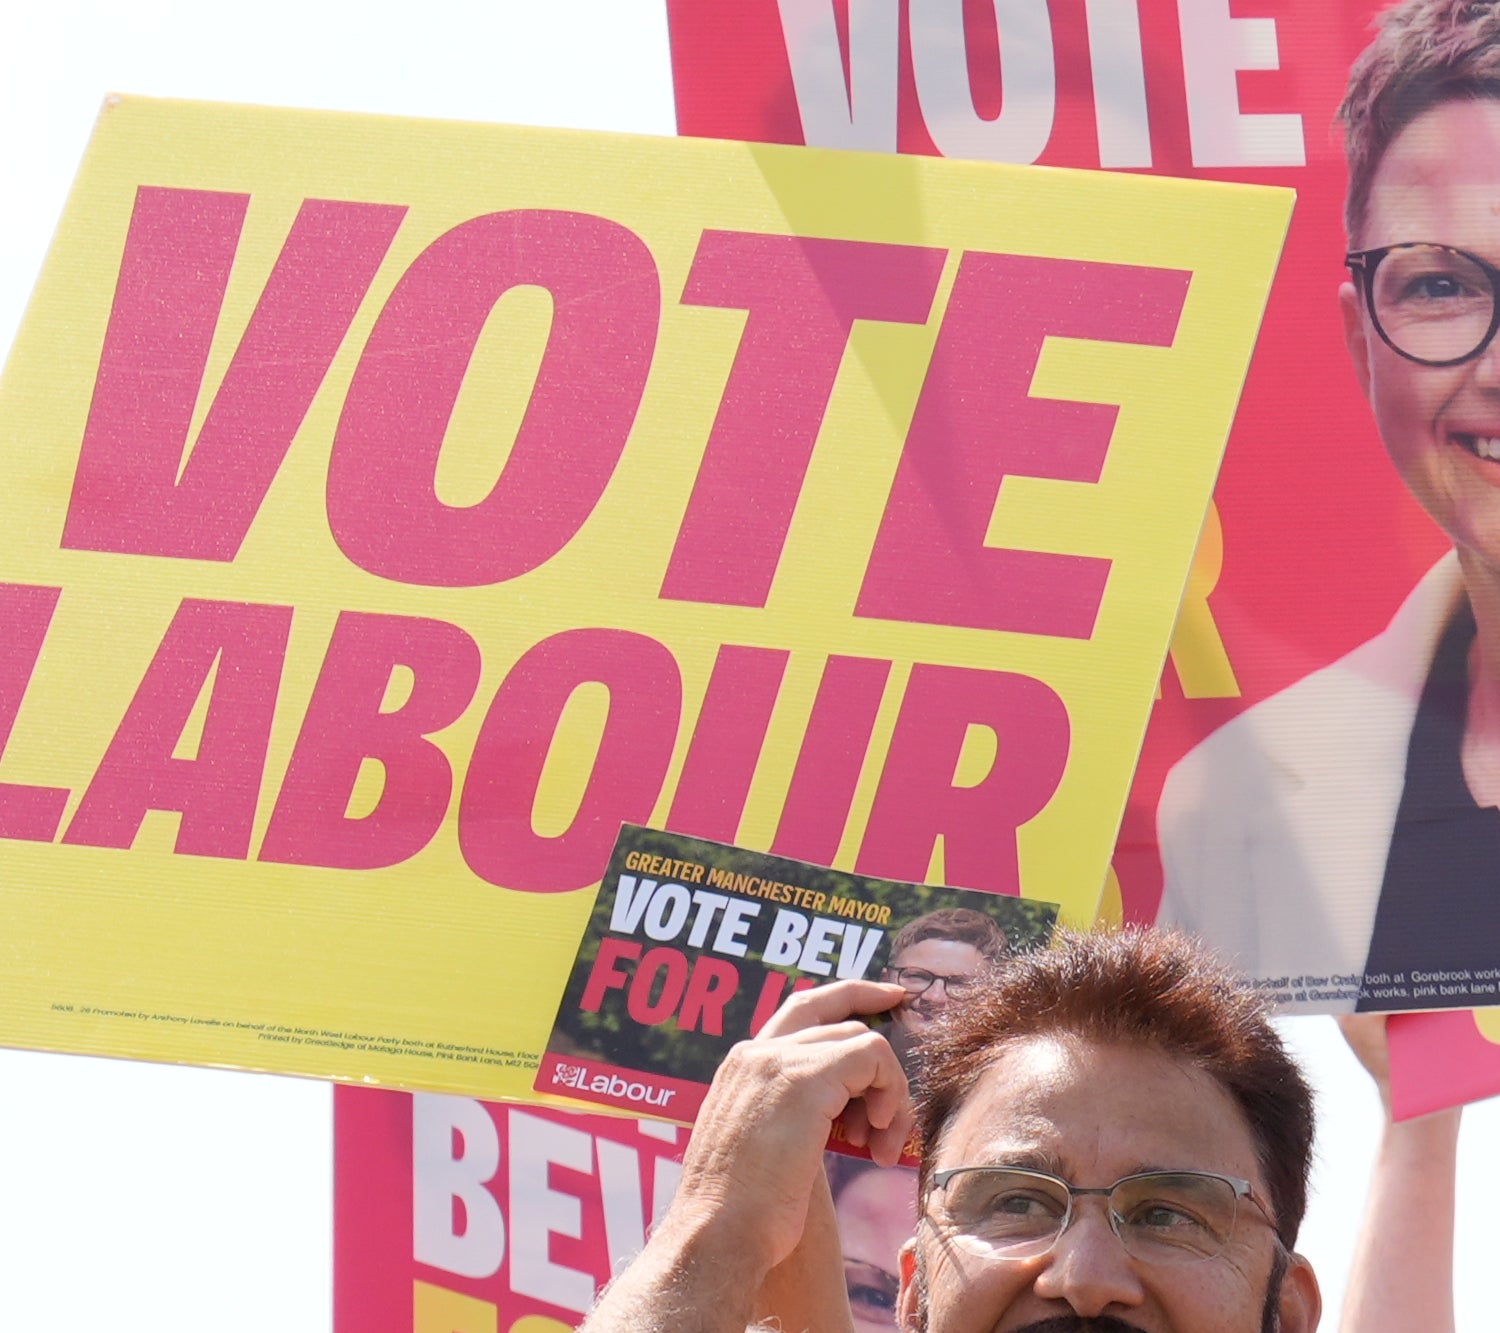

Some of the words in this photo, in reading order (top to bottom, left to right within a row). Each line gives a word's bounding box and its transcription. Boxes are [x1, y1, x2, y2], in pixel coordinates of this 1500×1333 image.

[61, 185, 1193, 640] VOTE
[0, 582, 1072, 897] LABOUR
[626, 851, 704, 883] GREATER
[707, 869, 826, 912] MANCHESTER
[828, 894, 892, 925] MAYOR
[609, 874, 762, 958] VOTE
[762, 910, 884, 980] BEV
[579, 937, 739, 1036] FOR
[1366, 972, 1390, 984] both
[1394, 972, 1406, 984] at
[1411, 970, 1472, 982] Gorebrook
[1413, 984, 1437, 998] pink
[1440, 984, 1468, 995] bank
[1470, 982, 1496, 994] lane
[93, 1008, 136, 1018] Promoted
[138, 1012, 149, 1020] by
[152, 1014, 188, 1024] Anthony
[236, 1022, 264, 1030] behalf
[295, 1028, 318, 1036] North
[321, 1030, 342, 1038] West
[344, 1032, 374, 1042] Labour
[377, 1036, 400, 1046] Party
[402, 1038, 423, 1047] both
[437, 1042, 484, 1054] Rutherford
[517, 1052, 540, 1060] Floor
[258, 1034, 289, 1042] Printed
[436, 1051, 454, 1060] Pink
[456, 1054, 477, 1063] Bank
[576, 1067, 677, 1107] Labour
